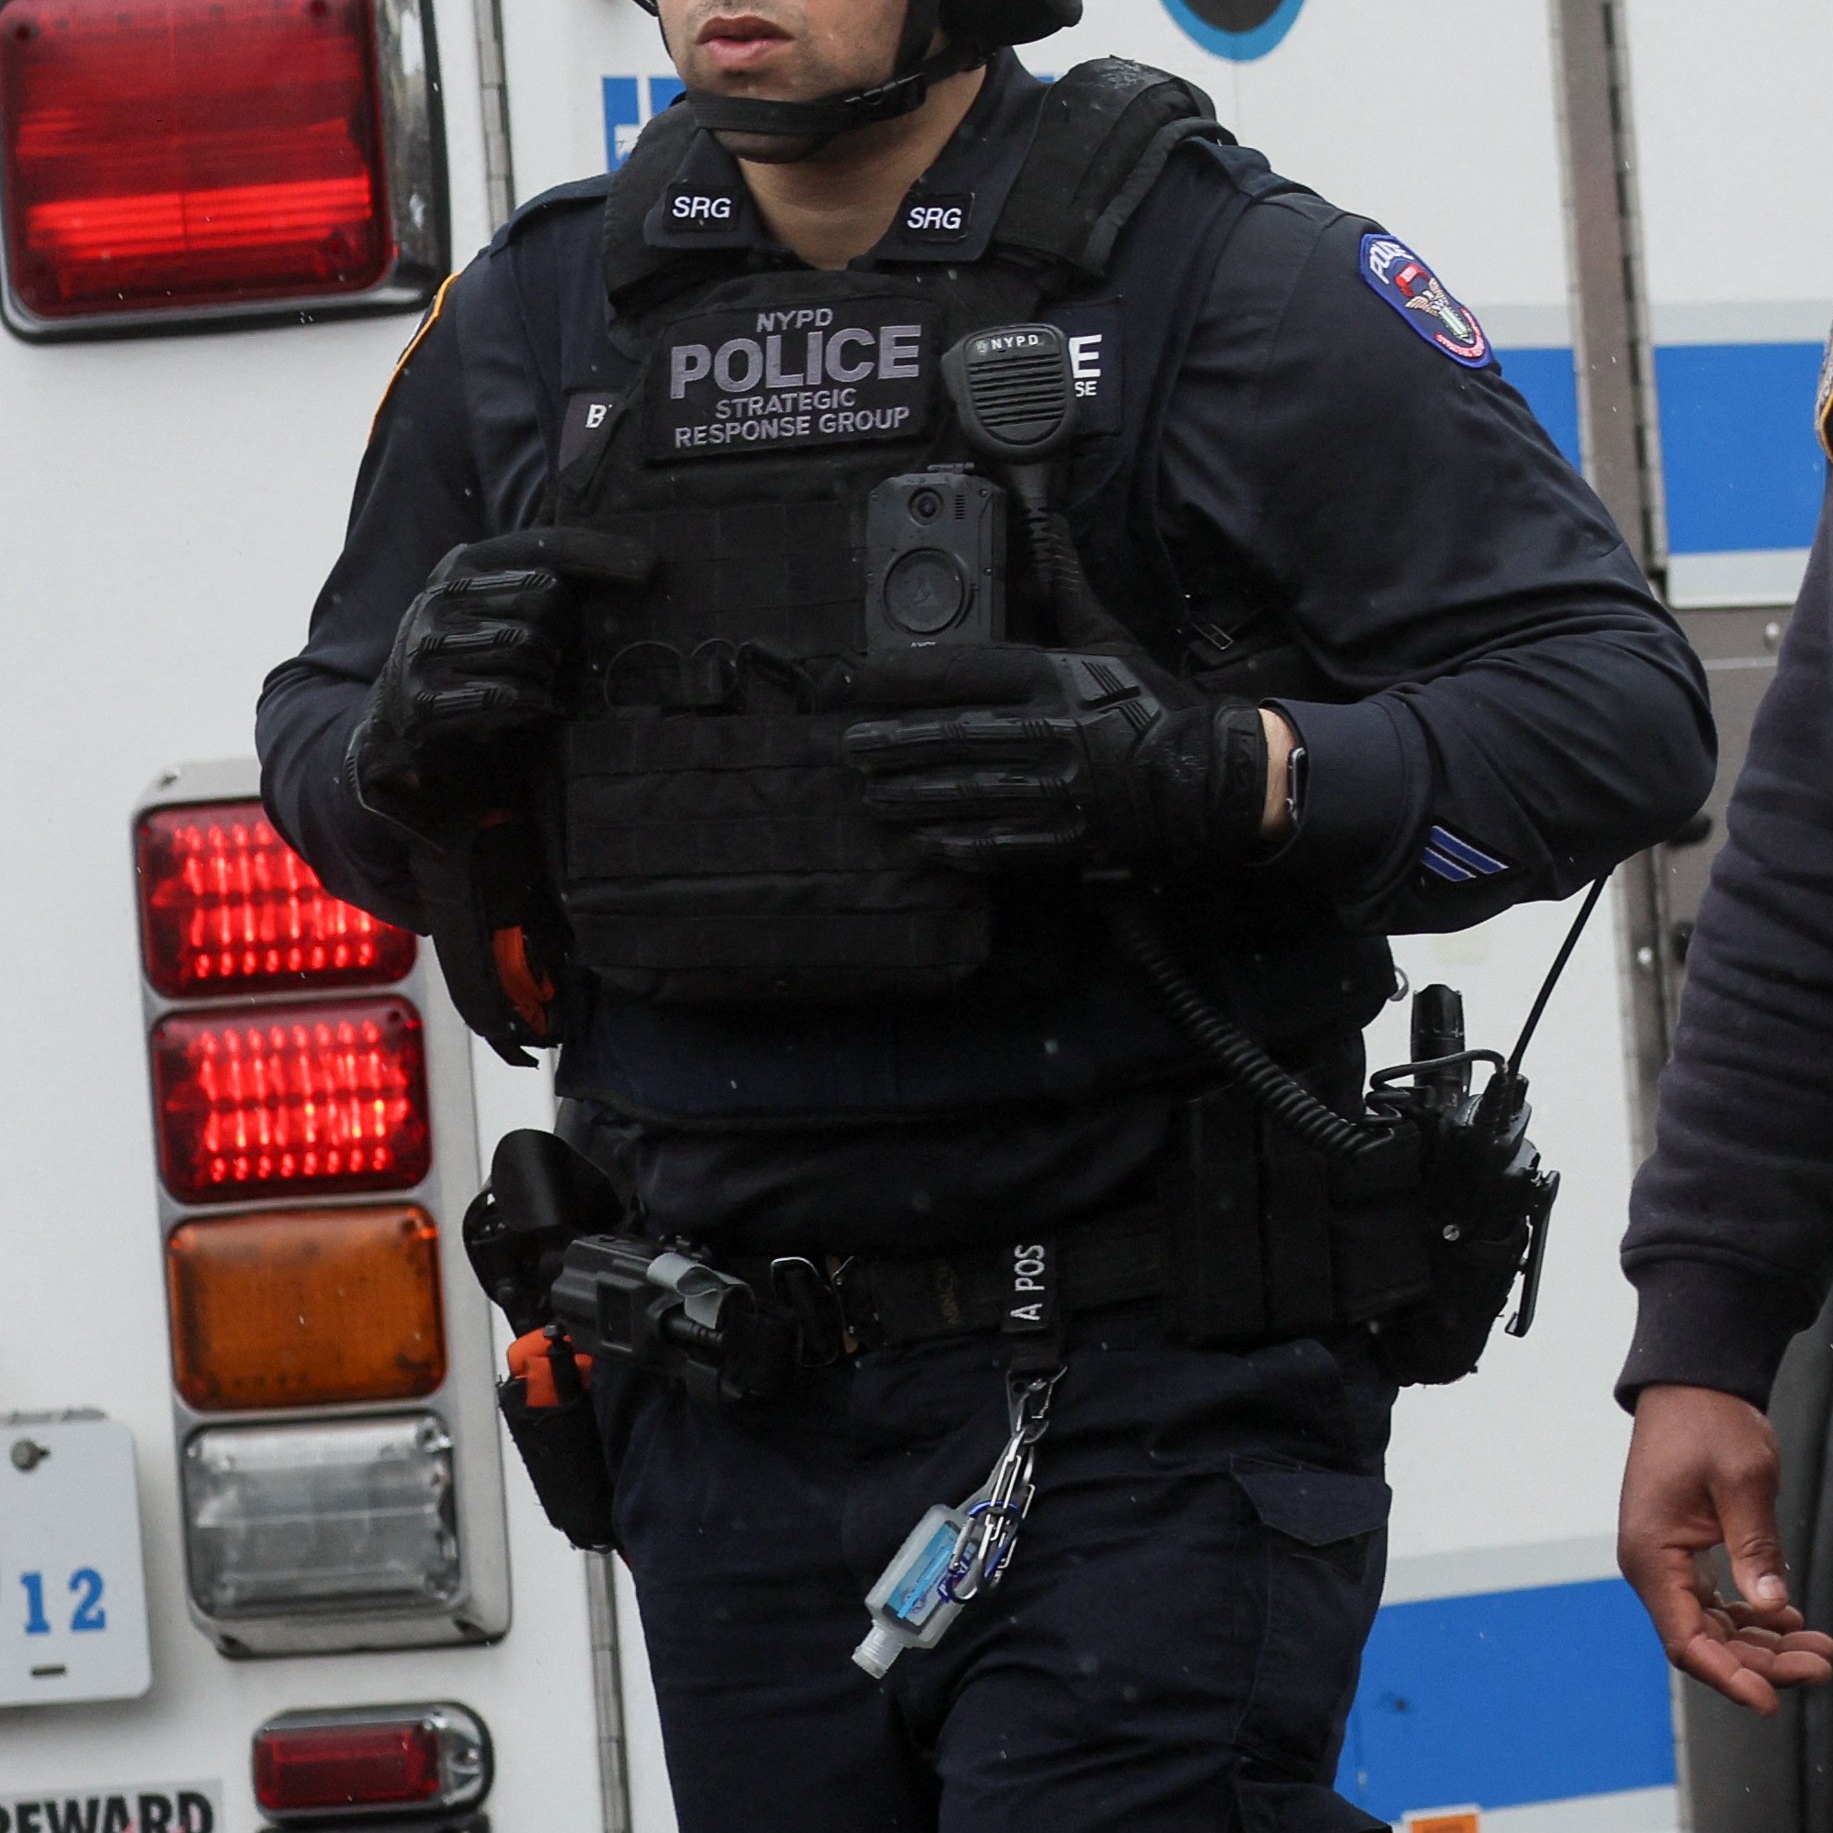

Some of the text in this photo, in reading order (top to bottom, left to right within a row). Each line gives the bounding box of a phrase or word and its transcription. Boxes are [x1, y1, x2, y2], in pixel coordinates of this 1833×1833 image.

[672, 196, 732, 220] SRG
[907, 206, 962, 230] SRG
[757, 308, 834, 333] NYPD
[991, 334, 1039, 350] NYPD
[669, 324, 922, 399] POLICE
[715, 387, 857, 420] STRATEGIC
[674, 406, 910, 449] RESPONSE GROUP
[1009, 1243, 1046, 1322] A POS
